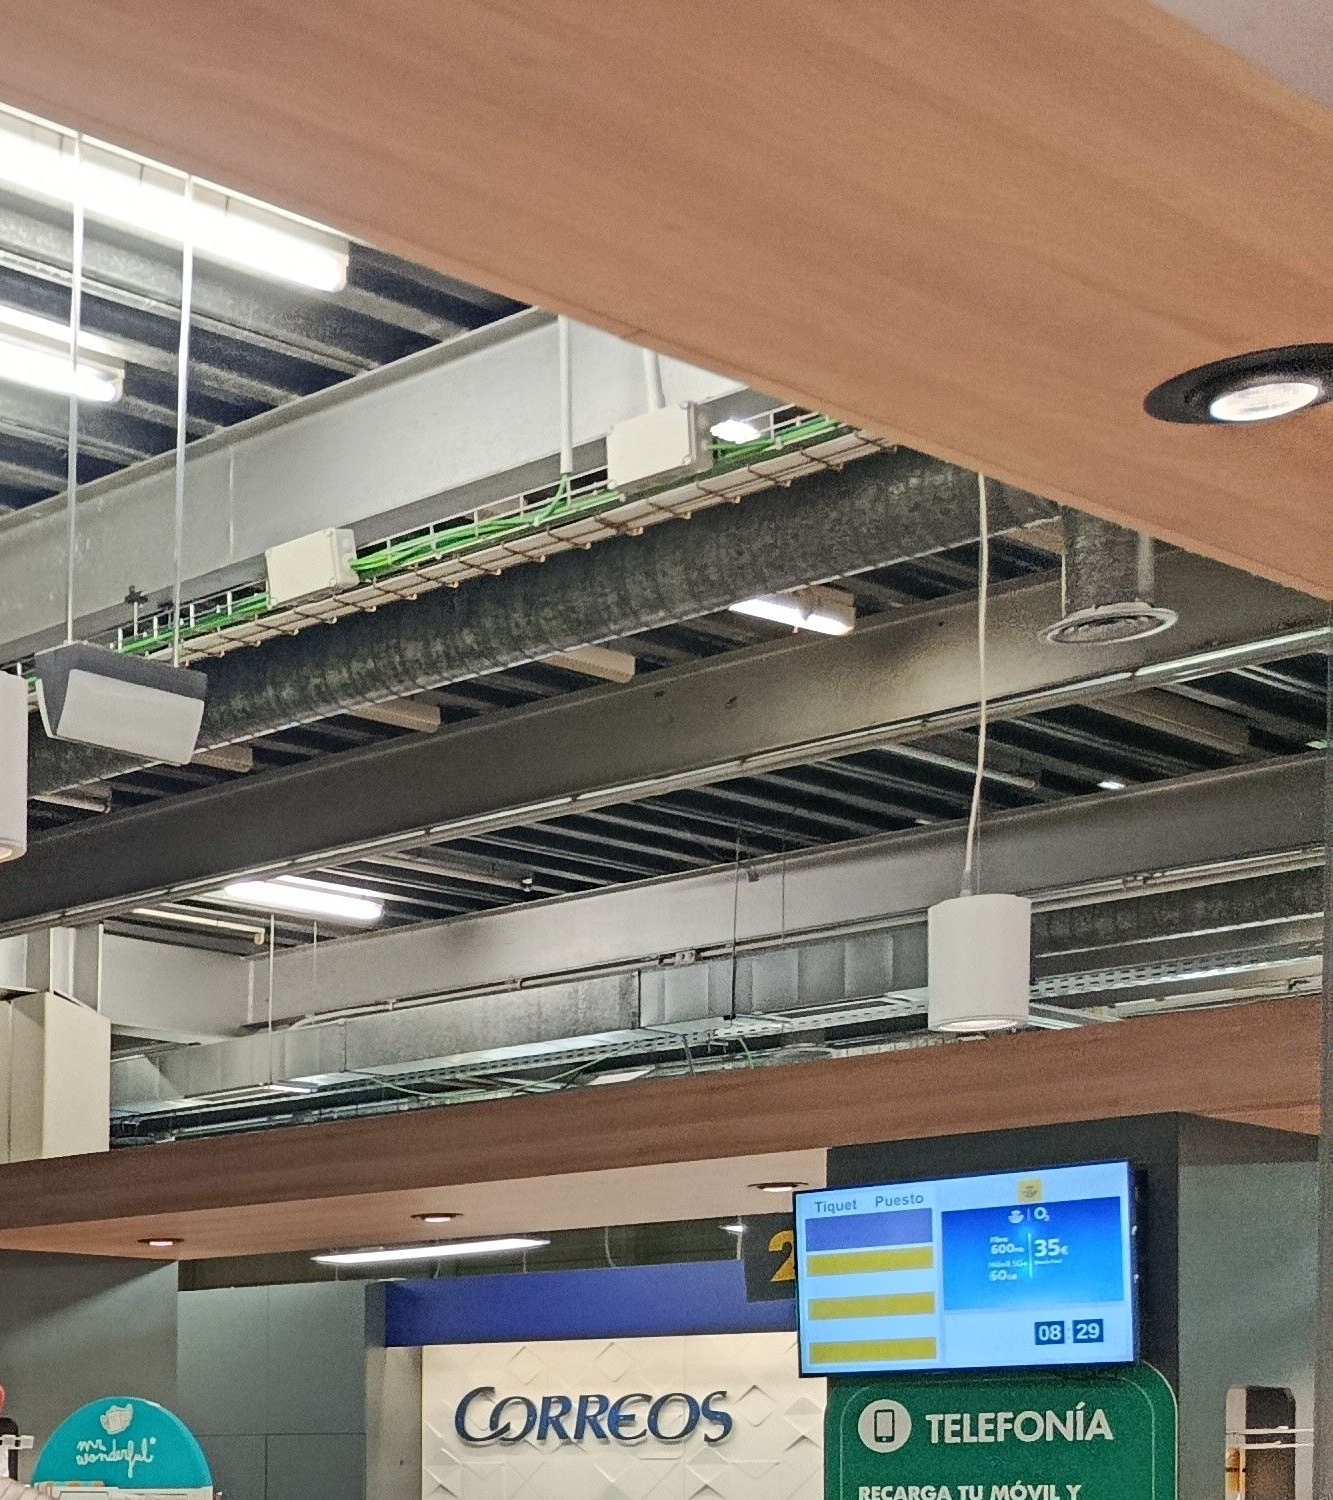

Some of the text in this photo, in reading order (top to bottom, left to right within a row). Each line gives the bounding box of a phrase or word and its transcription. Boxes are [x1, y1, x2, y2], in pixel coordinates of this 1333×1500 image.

[814, 1193, 924, 1214] Tiquet Puesto
[769, 1230, 796, 1282] 2
[1038, 1323, 1100, 1341] 08 29
[455, 1386, 732, 1443] CORREOS
[925, 1402, 1115, 1443] TELEFONÍA
[1066, 1484, 1082, 1500] Y
